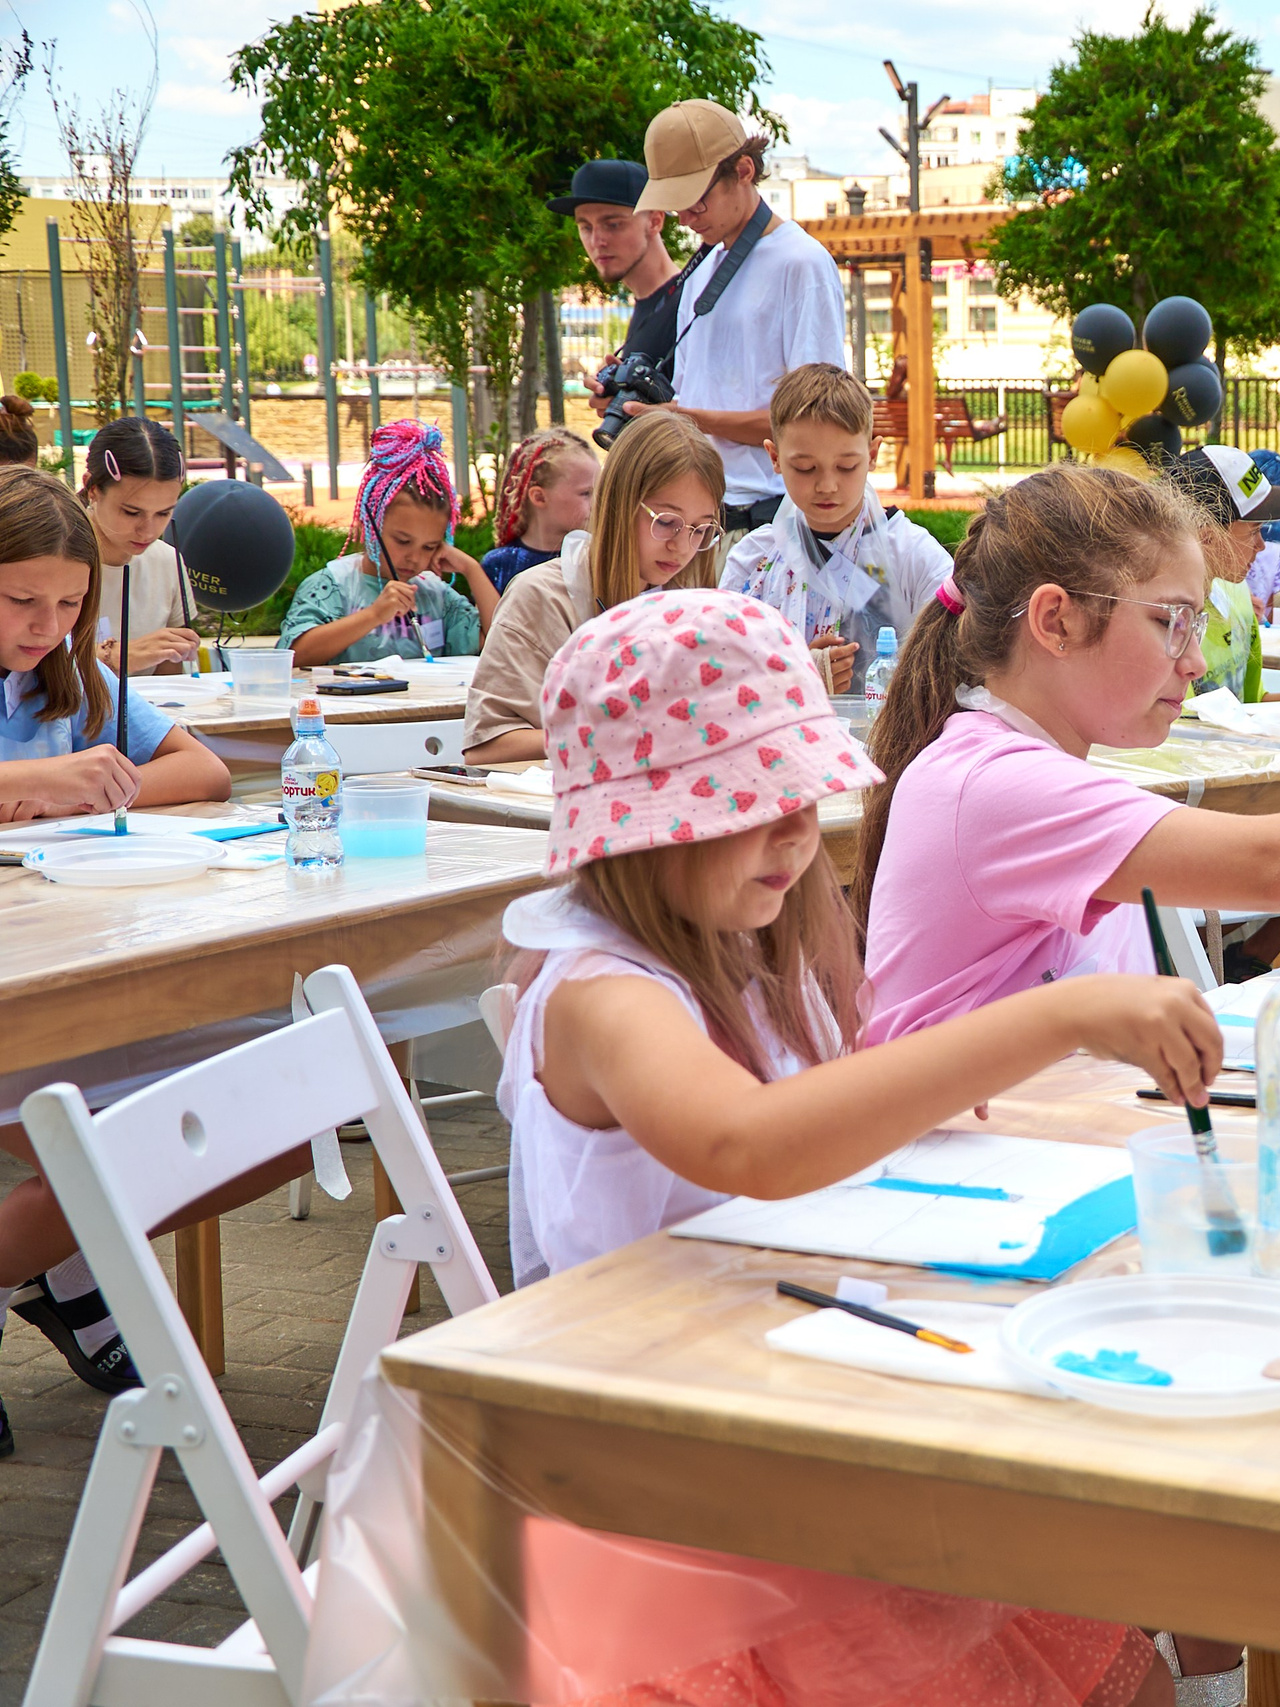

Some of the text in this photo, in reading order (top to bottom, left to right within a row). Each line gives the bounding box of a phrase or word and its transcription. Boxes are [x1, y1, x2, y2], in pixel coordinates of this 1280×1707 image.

[188, 567, 221, 585] IVER
[189, 578, 228, 595] OUSE
[281, 785, 316, 798] ортик
[102, 1342, 128, 1370] LOV
